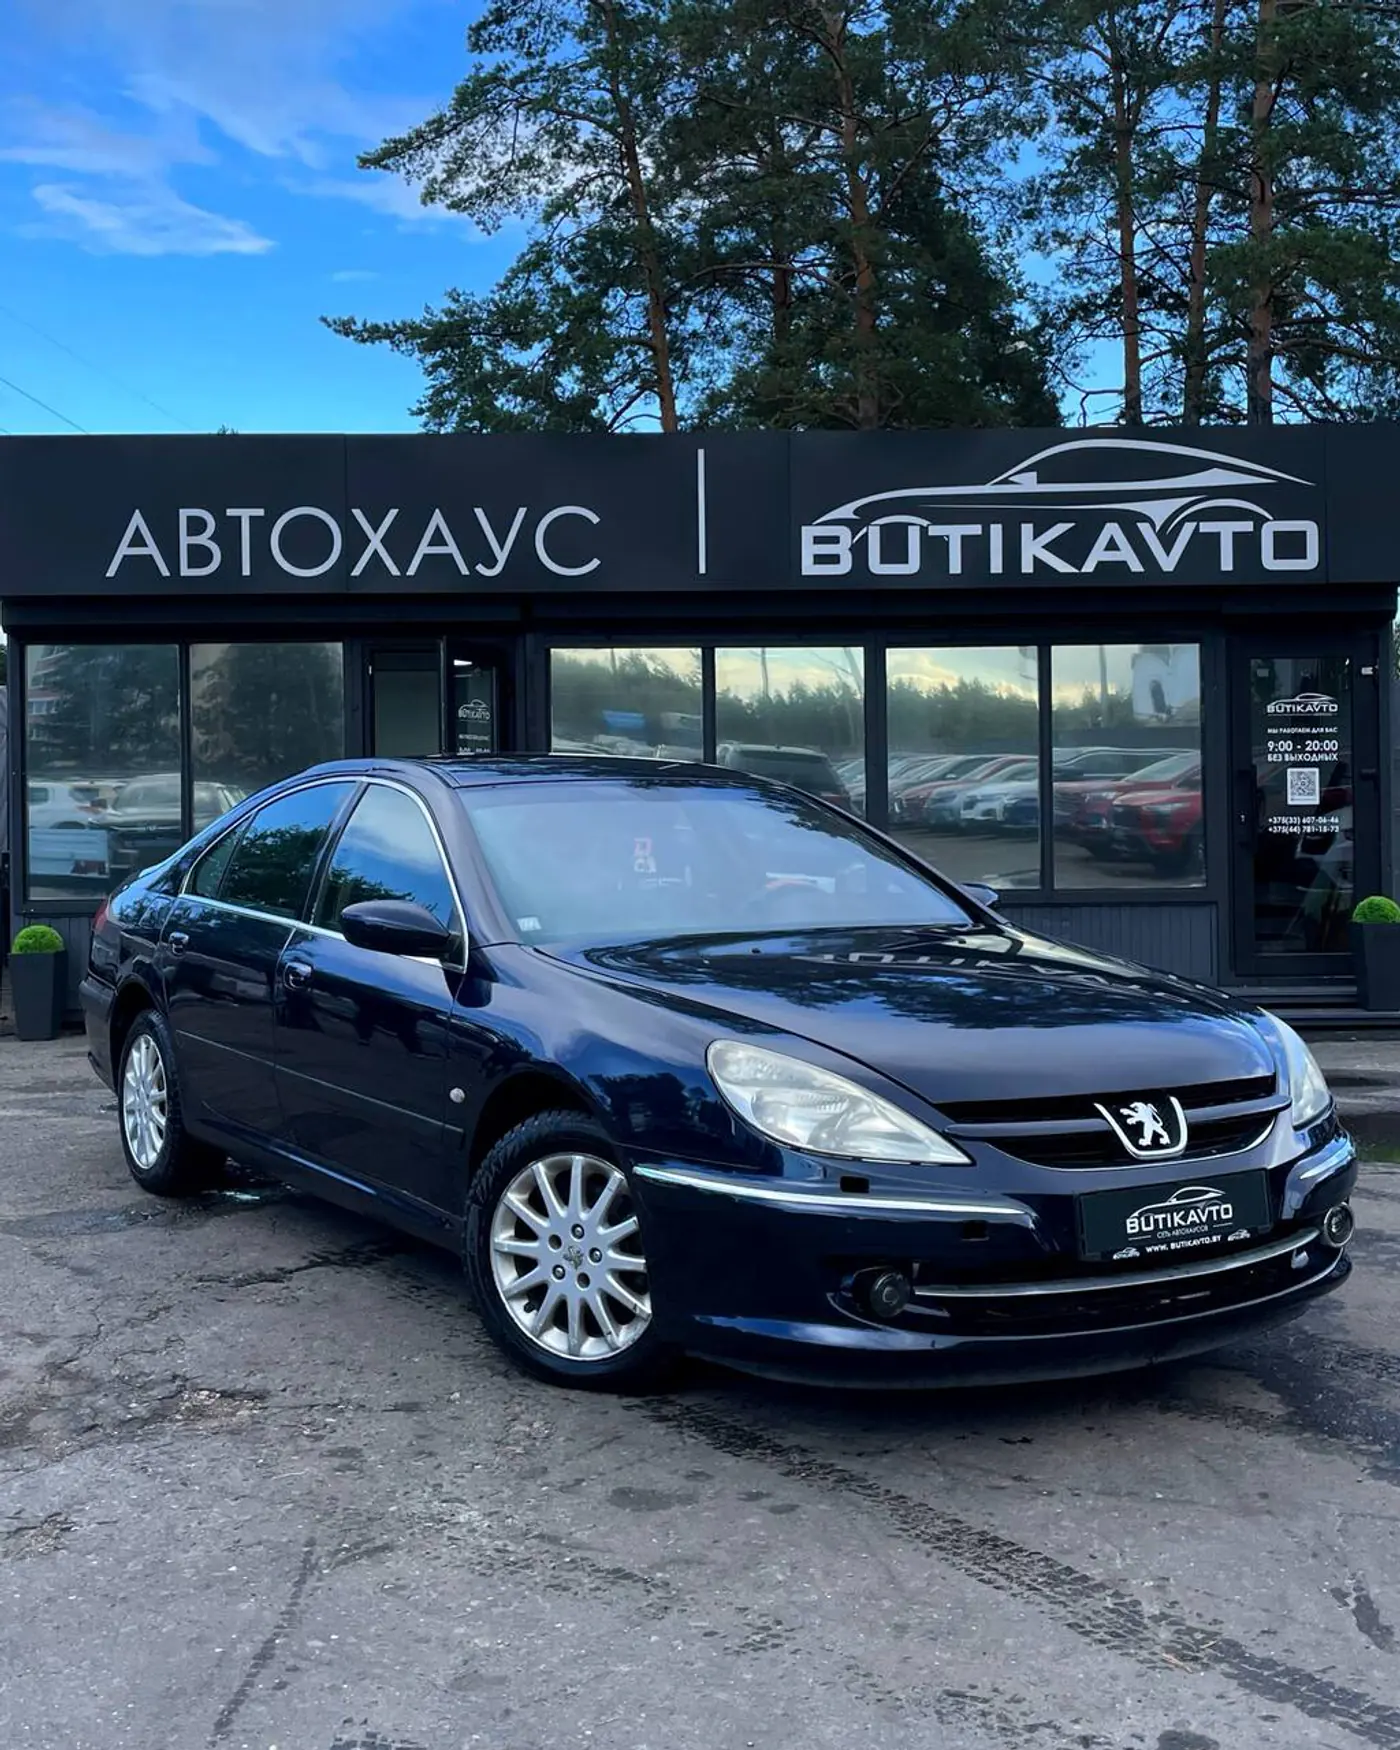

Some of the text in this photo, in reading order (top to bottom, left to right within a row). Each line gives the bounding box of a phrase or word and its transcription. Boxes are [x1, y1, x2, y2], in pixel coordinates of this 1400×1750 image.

[105, 505, 601, 578] АВТОХАУС
[801, 519, 1319, 576] BUTIKAVTO
[1267, 703, 1339, 713] BUTIKAVTO
[1267, 740, 1293, 752] 9:00
[1305, 739, 1339, 752] 20:00
[1267, 752, 1339, 762] БЕЗ ВЫХОДНЫХ
[1126, 1203, 1233, 1234] BUTIKAVTO
